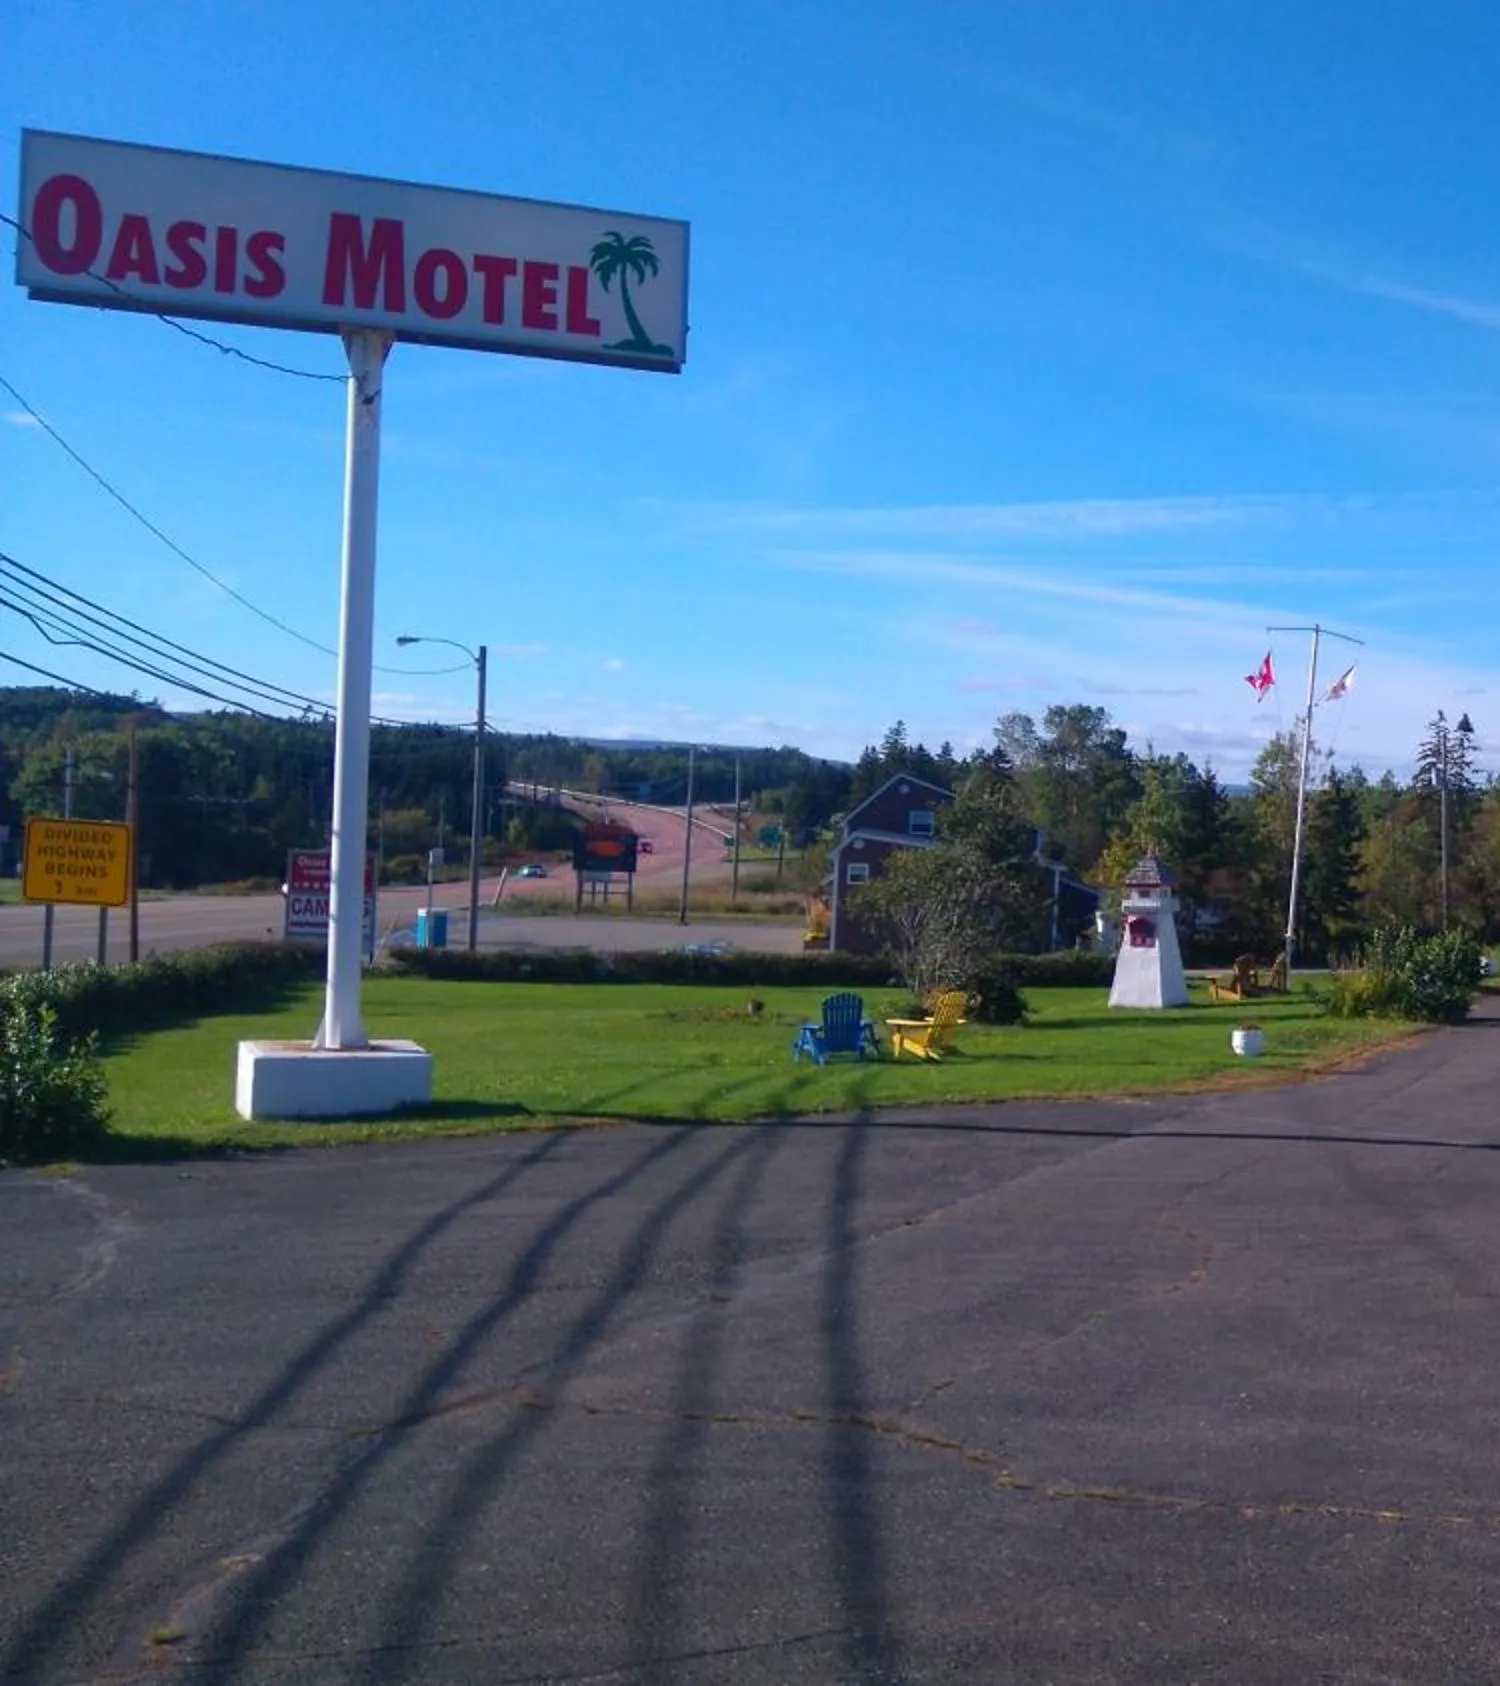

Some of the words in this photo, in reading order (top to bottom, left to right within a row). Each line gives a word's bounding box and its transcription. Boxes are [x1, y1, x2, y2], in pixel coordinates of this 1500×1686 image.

[32, 174, 286, 297] OASIS
[322, 212, 601, 336] MOTEL
[44, 828, 113, 844] DIVIDED
[38, 845, 117, 862] HIGHWAY
[45, 861, 108, 878] BEGINS
